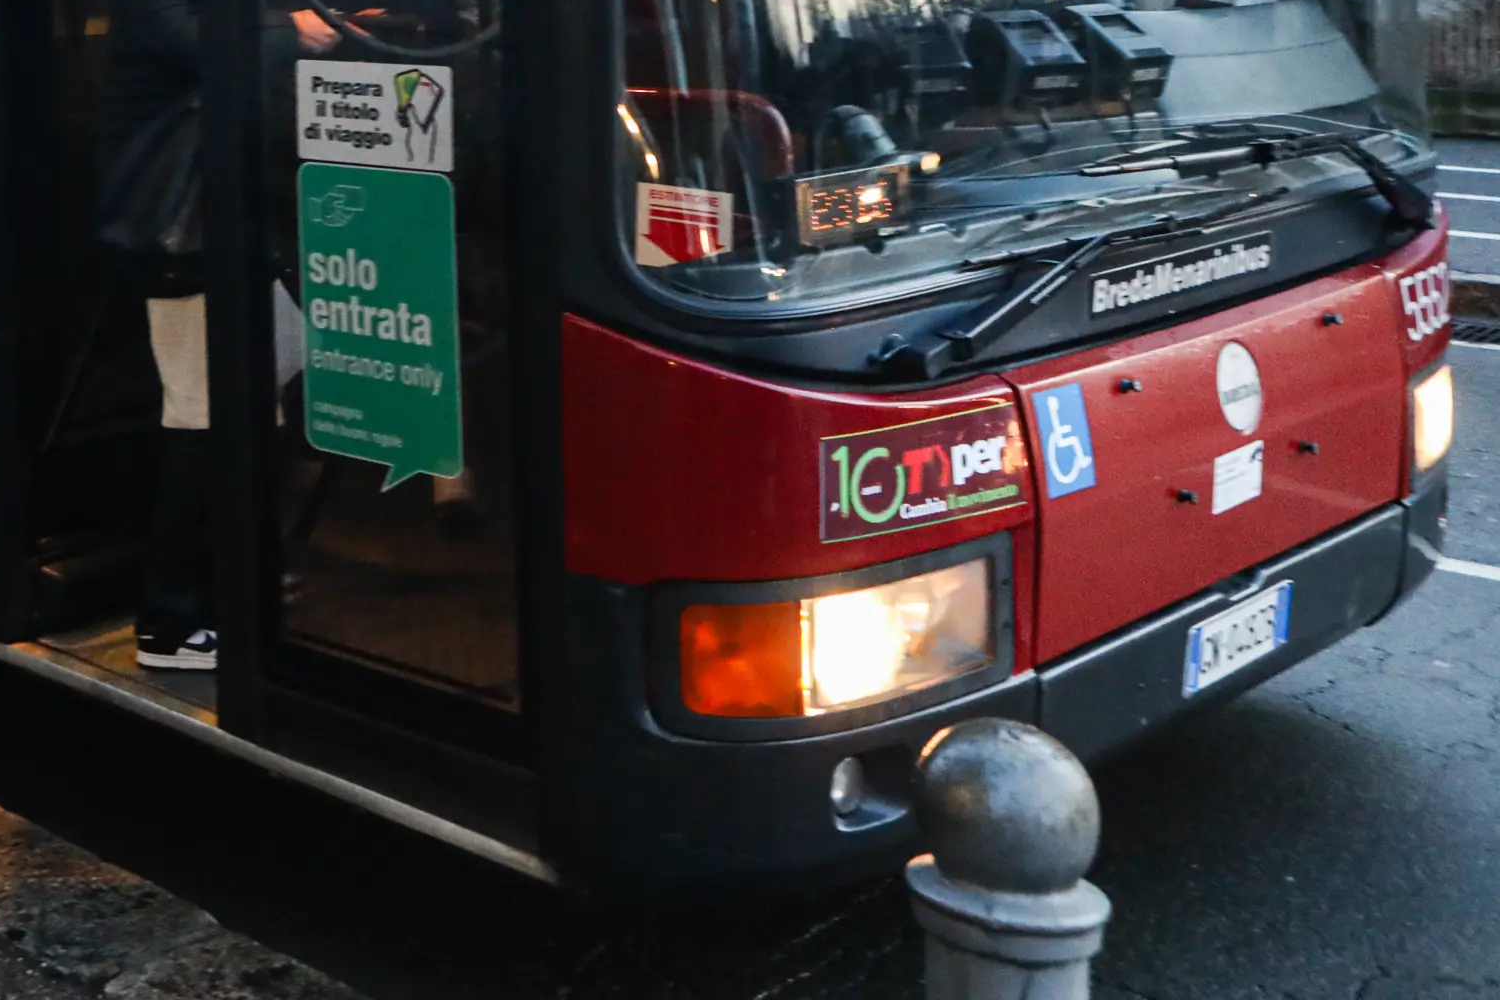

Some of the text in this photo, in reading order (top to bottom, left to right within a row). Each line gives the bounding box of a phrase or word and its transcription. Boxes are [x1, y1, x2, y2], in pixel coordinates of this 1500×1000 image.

[311, 76, 383, 98] Prepara
[316, 100, 380, 121] il titolo
[304, 123, 393, 149] di viaggio
[307, 248, 378, 291] solo
[1092, 244, 1271, 313] BredaMenarinibus
[310, 296, 433, 347] entrata
[310, 347, 444, 396] entrance only
[831, 445, 906, 523] 10
